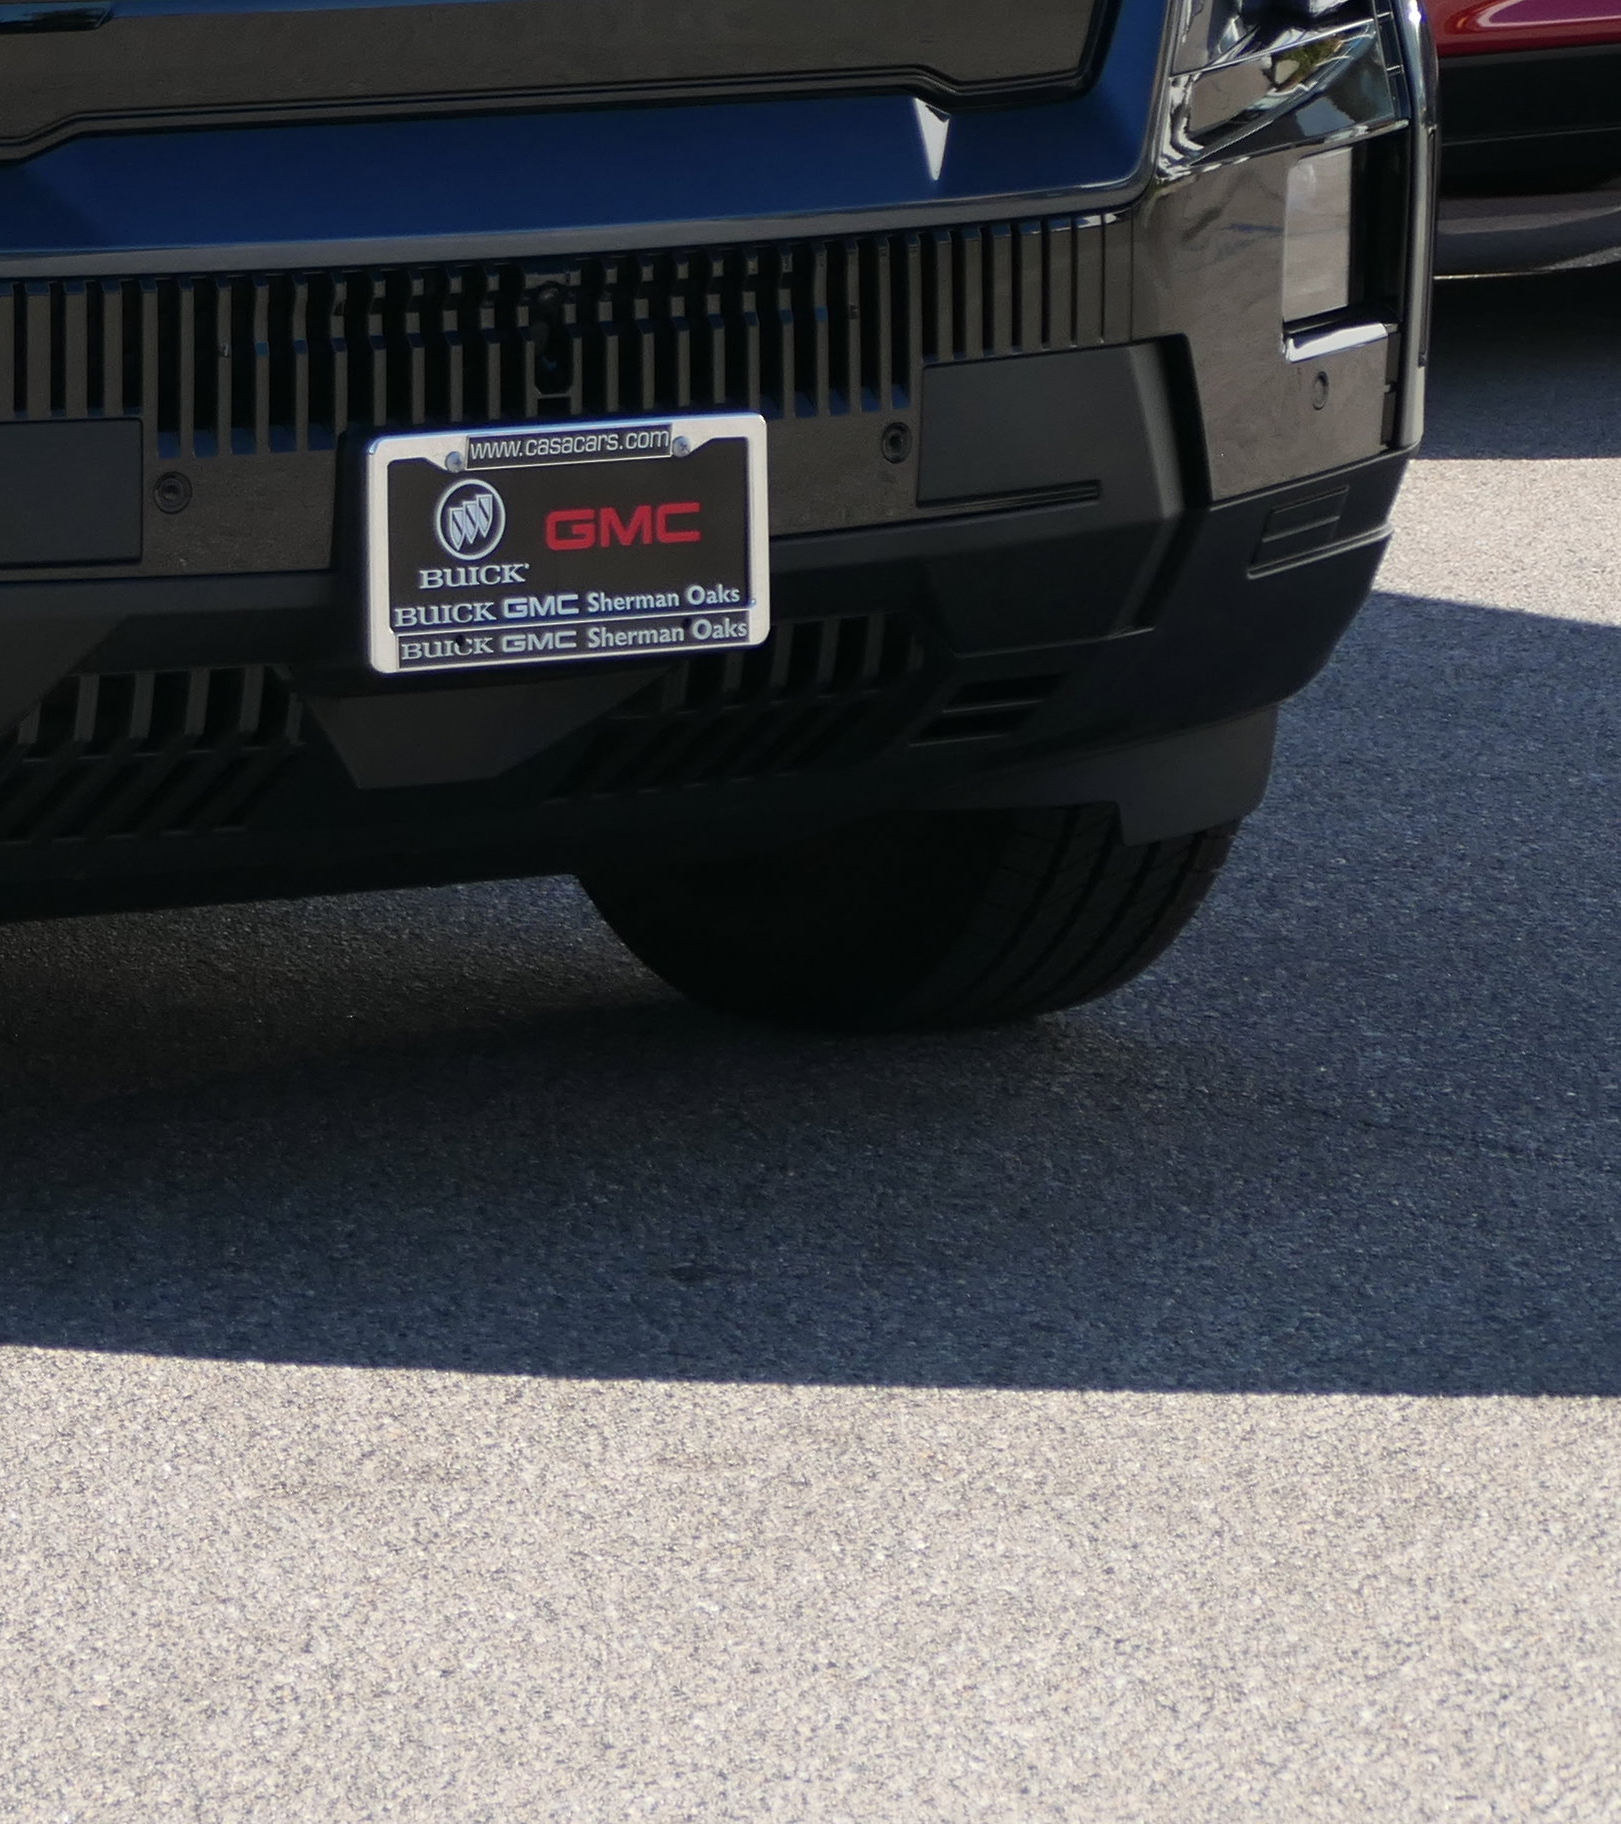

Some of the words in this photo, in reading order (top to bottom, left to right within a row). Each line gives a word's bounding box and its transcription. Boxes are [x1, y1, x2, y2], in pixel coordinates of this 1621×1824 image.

[469, 426, 672, 461] www.casacars.com
[544, 501, 702, 551] GMC
[418, 563, 526, 590] BUICK
[394, 601, 497, 629] BUICK
[502, 593, 580, 618] GMC
[586, 589, 680, 614] Sherman
[686, 583, 741, 606] Oaks
[401, 636, 495, 661] BUICK
[501, 631, 578, 654] GMC
[587, 624, 685, 650] Sherman
[692, 619, 748, 641] Oaks
